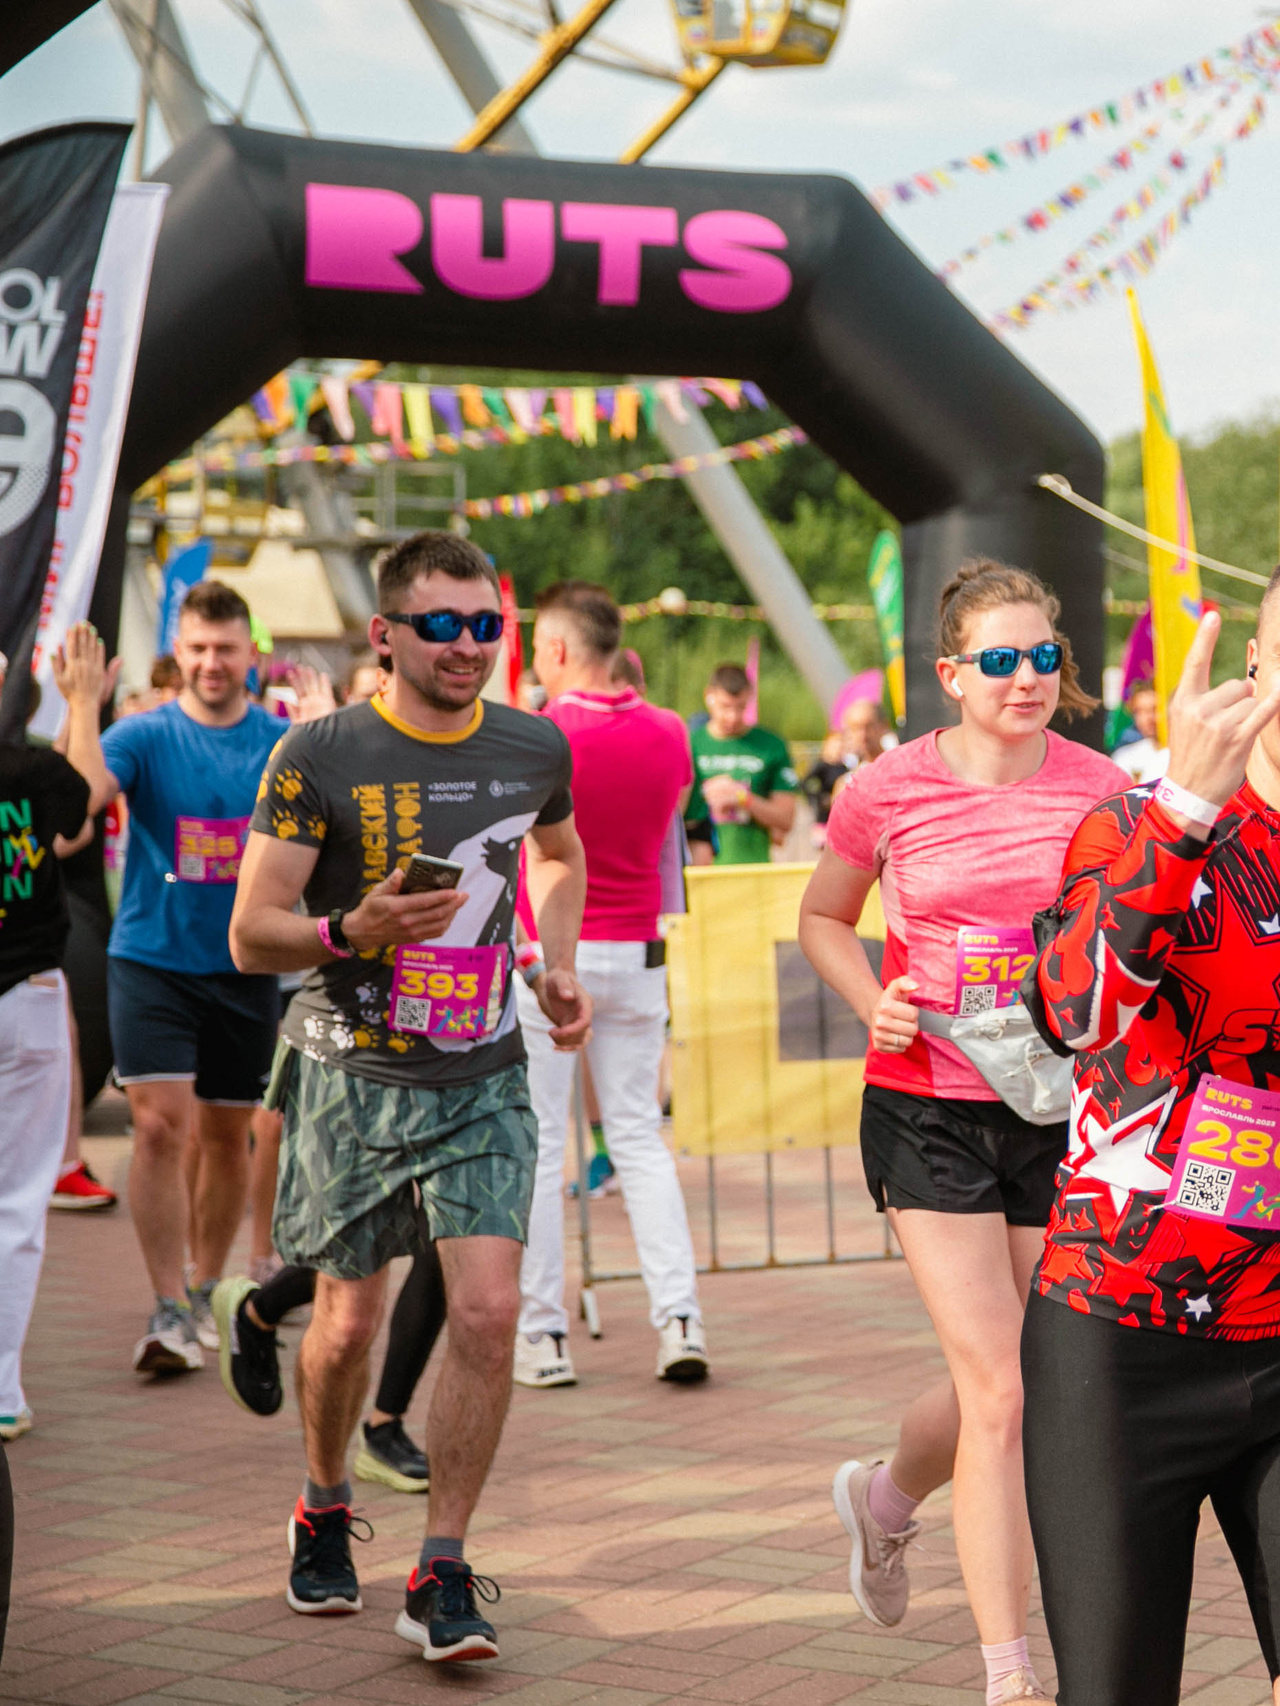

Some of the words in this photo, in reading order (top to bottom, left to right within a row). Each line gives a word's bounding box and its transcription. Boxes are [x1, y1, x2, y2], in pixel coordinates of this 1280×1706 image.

[304, 181, 793, 313] RUTS
[961, 953, 1036, 983] 312
[398, 969, 479, 1000] 393
[1204, 1087, 1253, 1110] RUTS
[1201, 1104, 1255, 1124] ЯРОСЛАВЛЬ
[1255, 1118, 1276, 1127] 2023
